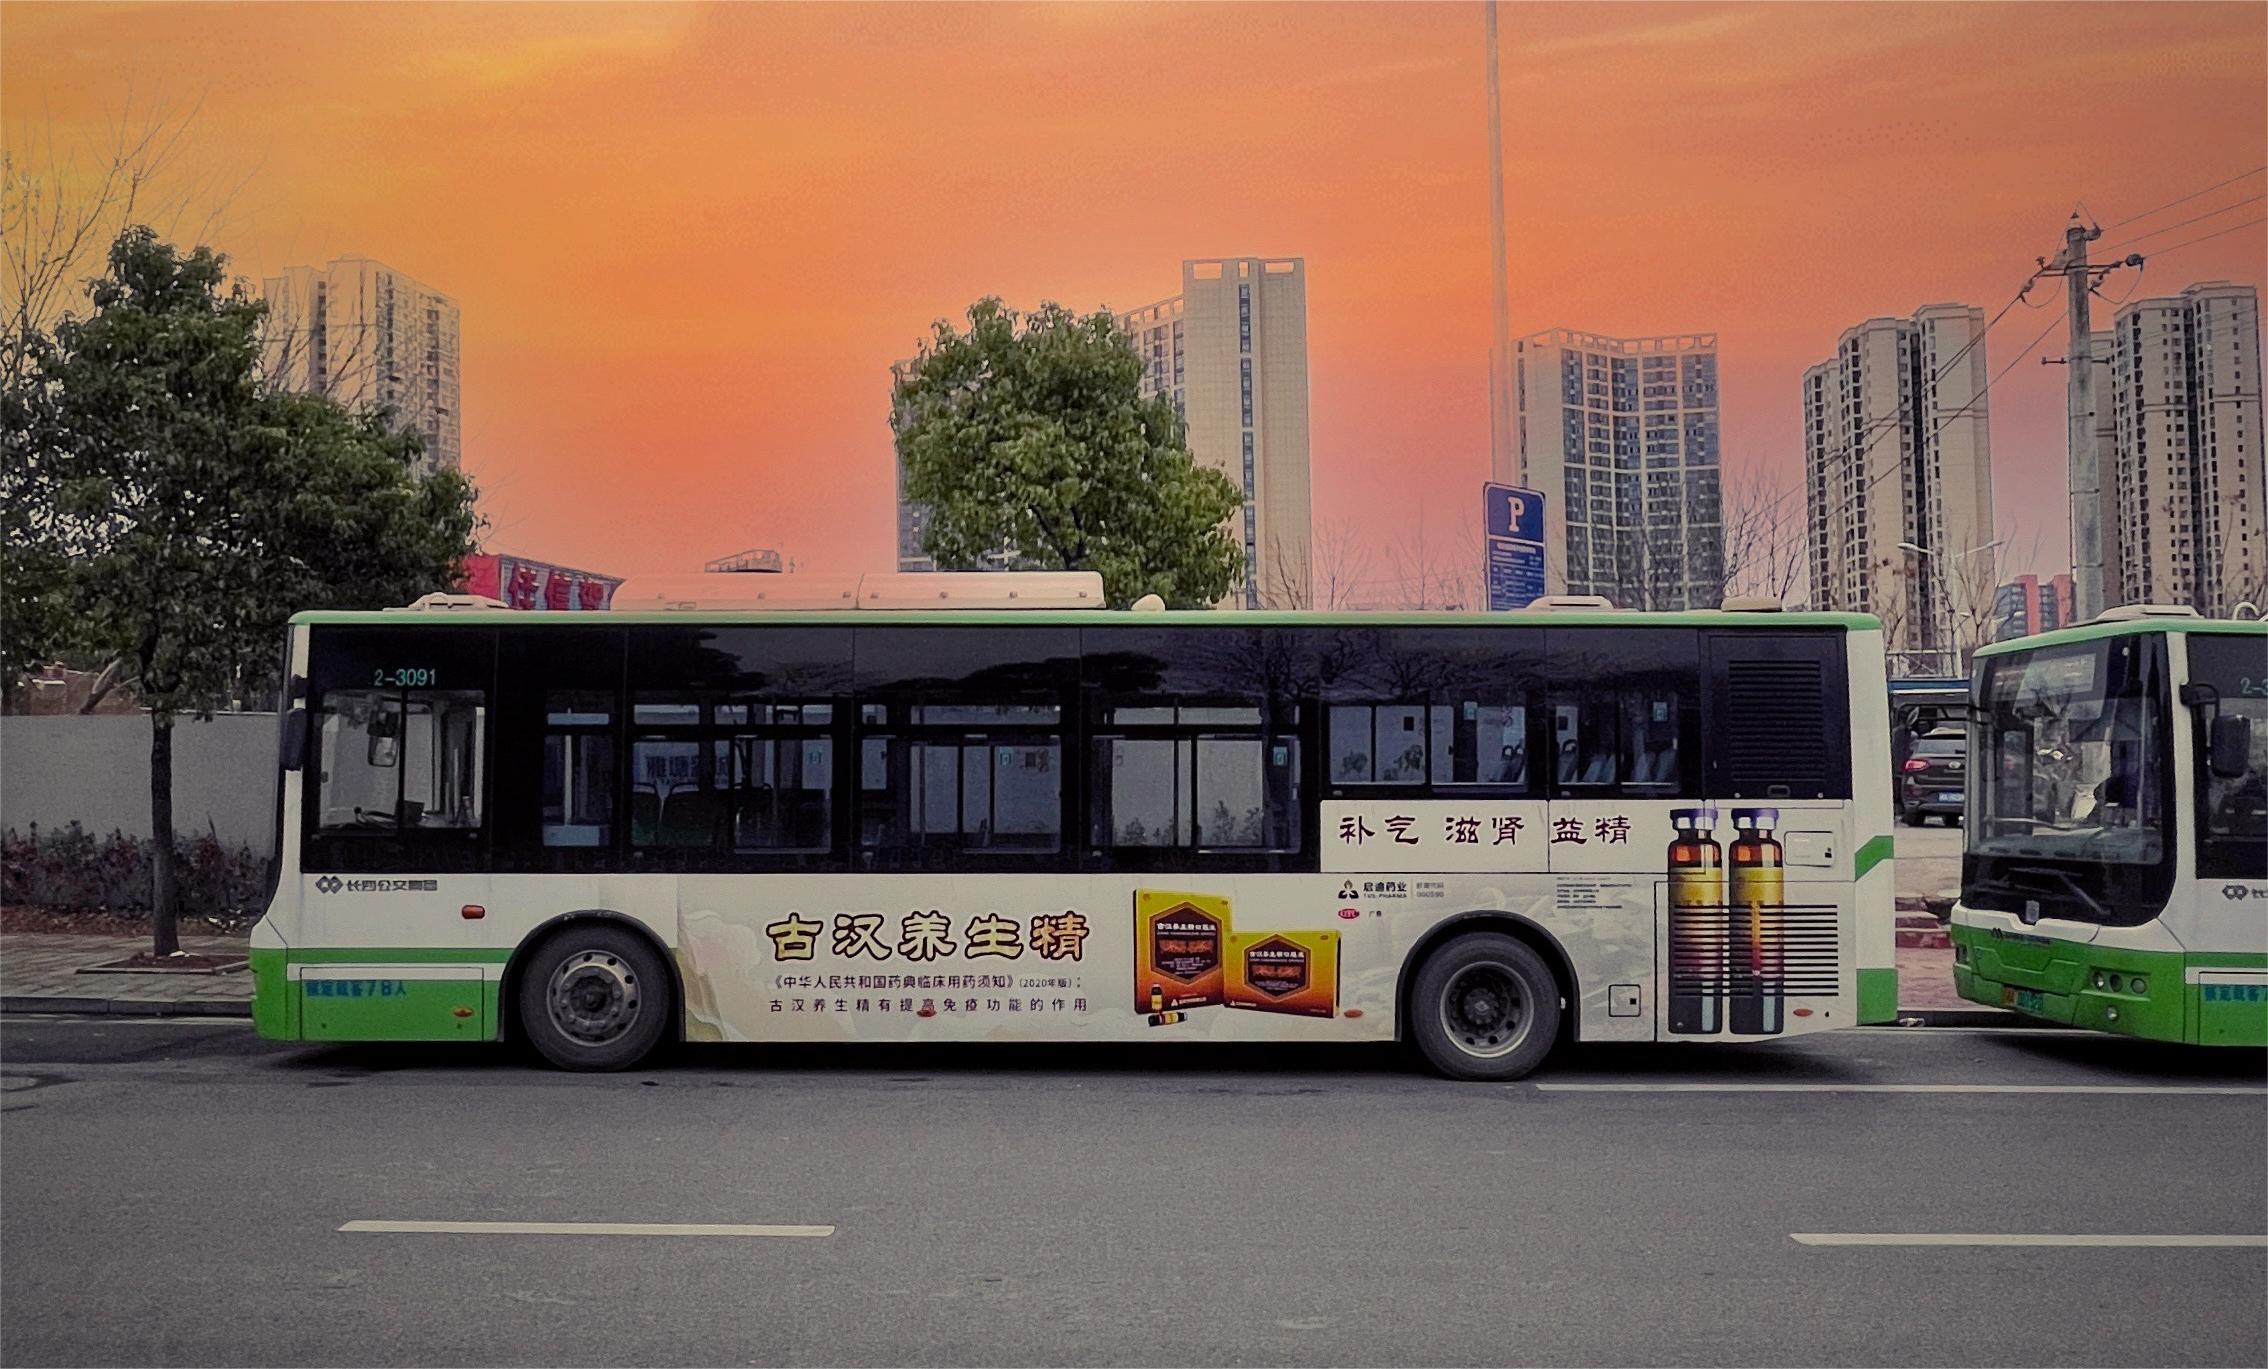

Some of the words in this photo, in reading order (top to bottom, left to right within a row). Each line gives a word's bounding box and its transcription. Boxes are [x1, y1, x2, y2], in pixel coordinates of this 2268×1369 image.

[1507, 496, 1525, 532] P
[374, 668, 436, 686] 2-3091
[1339, 815, 1419, 845] 补气
[1445, 815, 1525, 846] 滋肾
[1550, 815, 1632, 845] 益精
[766, 909, 1090, 962] 古汉养生精
